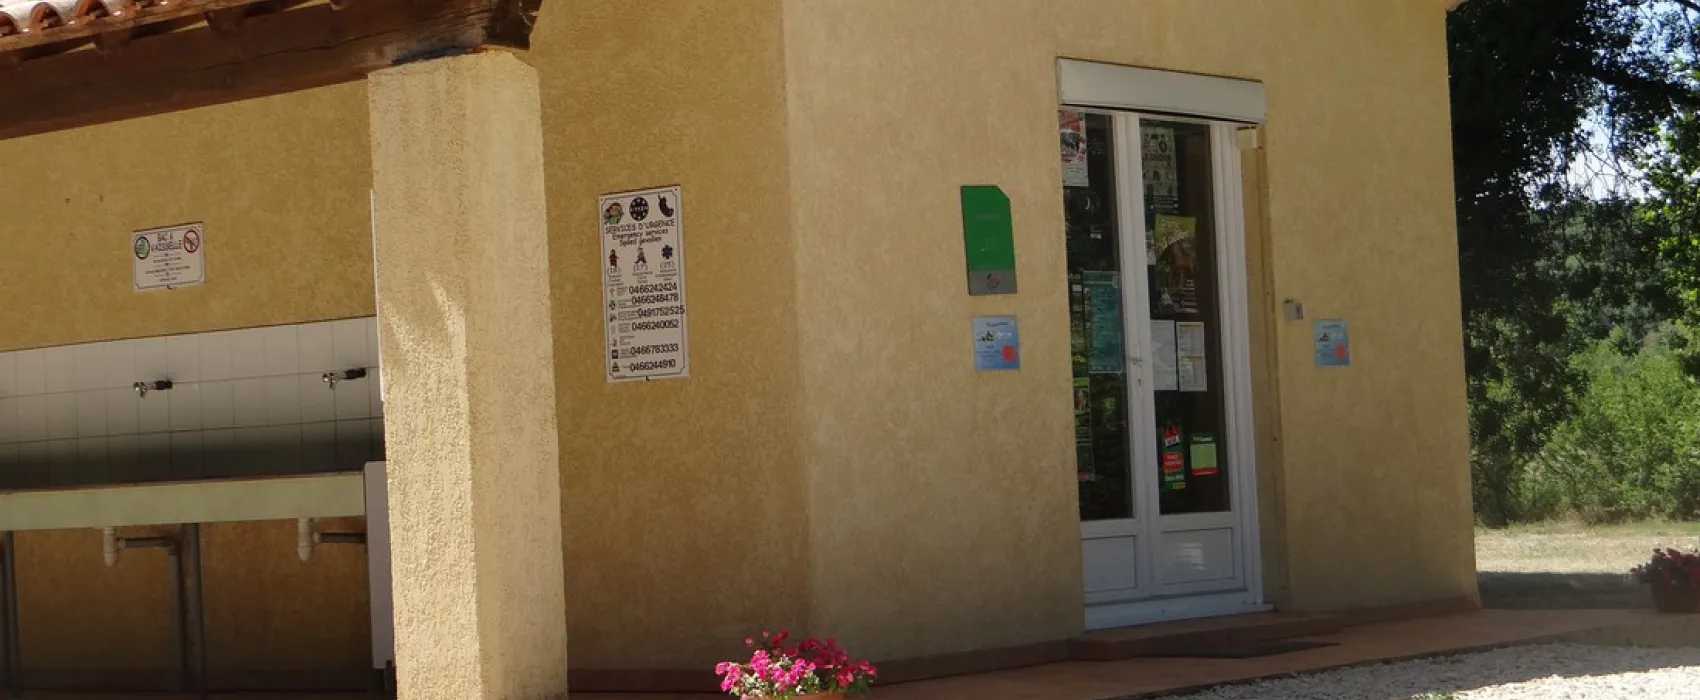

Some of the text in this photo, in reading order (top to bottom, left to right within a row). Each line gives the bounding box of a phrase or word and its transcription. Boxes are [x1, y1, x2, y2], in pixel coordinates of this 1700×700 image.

[605, 219, 675, 234] SERVICES D'URGENCE
[611, 228, 669, 241] Emergency services
[639, 236, 662, 246] gevallen
[629, 282, 678, 294] 0466242424
[637, 305, 685, 318] 0491752525
[630, 343, 679, 355] 0466783333
[630, 359, 676, 372] 0466244910
